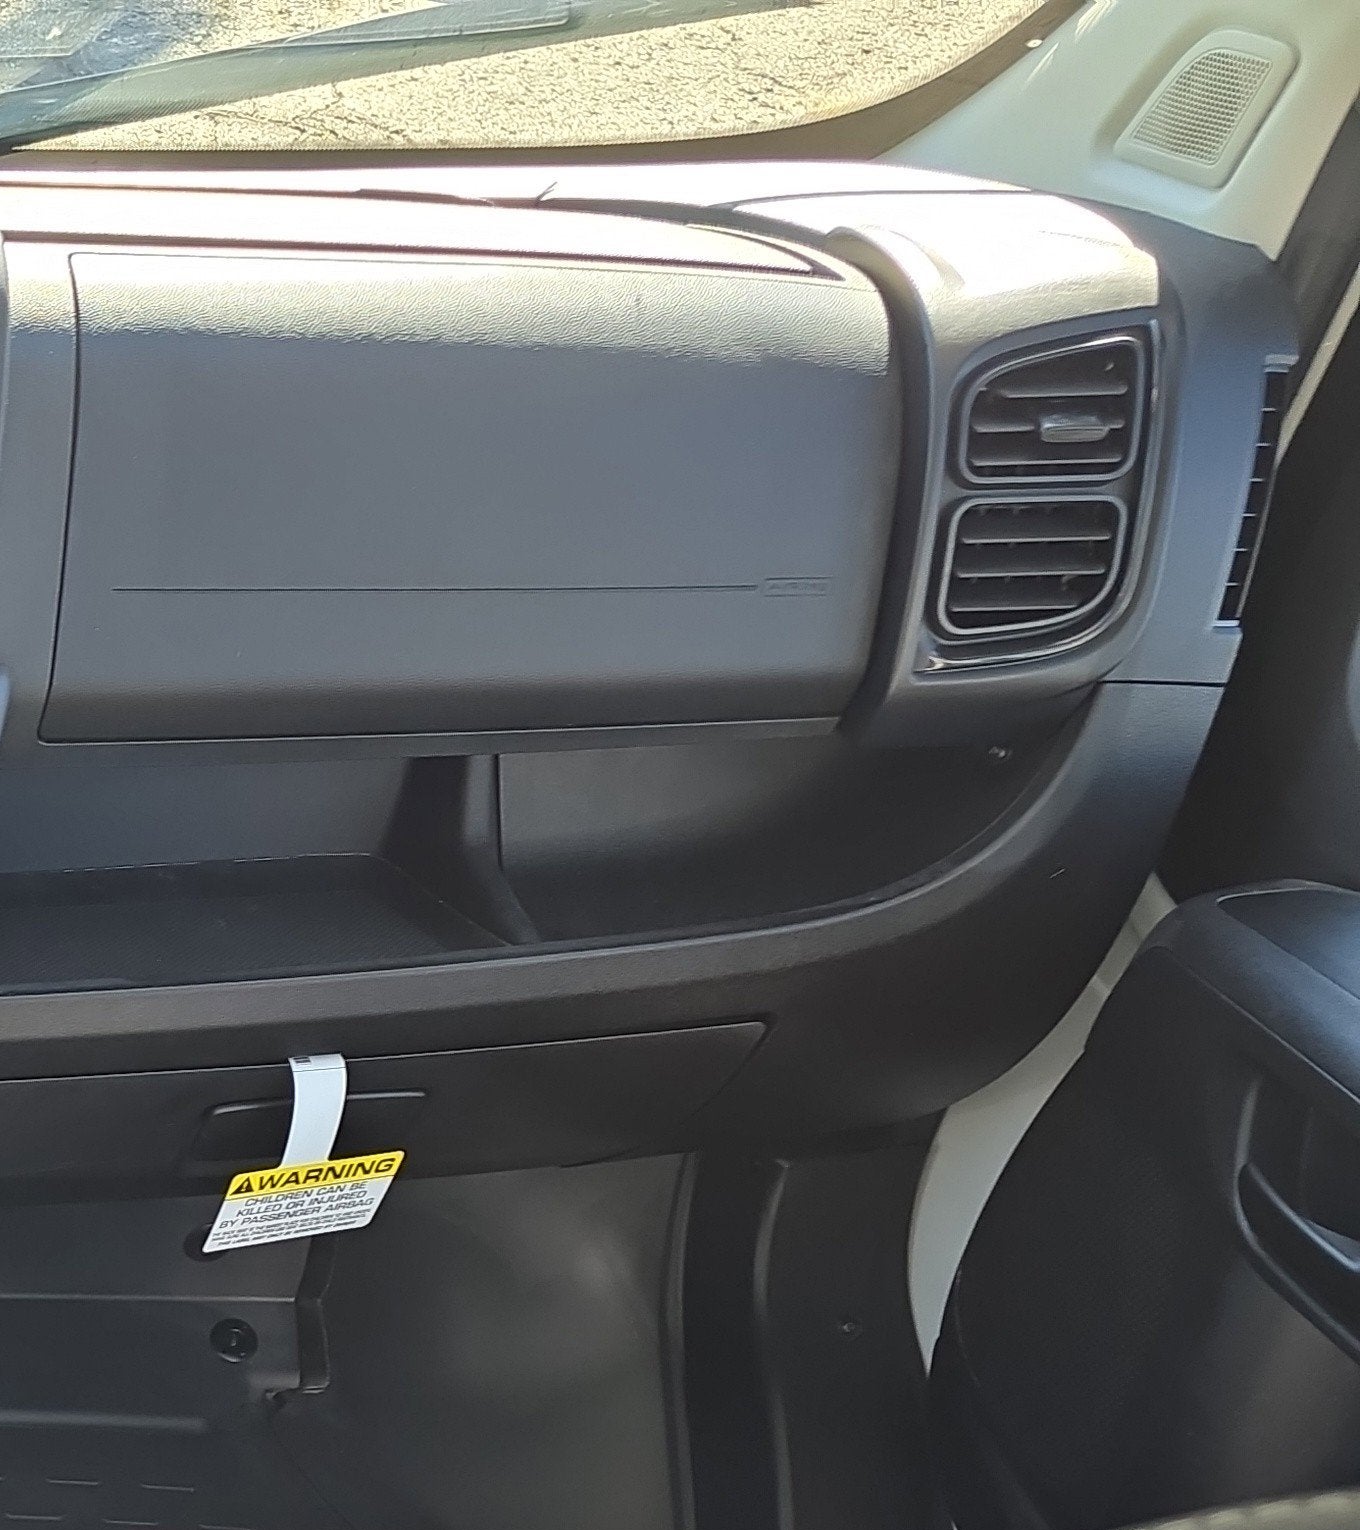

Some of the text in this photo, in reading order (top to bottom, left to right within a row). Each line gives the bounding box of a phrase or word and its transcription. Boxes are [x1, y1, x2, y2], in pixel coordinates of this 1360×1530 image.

[258, 1158, 395, 1191] WARNING
[236, 1191, 367, 1217] KILLED OR INJURED
[245, 1181, 367, 1206] CHILDREN CAN BE
[219, 1219, 239, 1228] BY
[241, 1206, 321, 1225] PASSENGER
[323, 1198, 374, 1212] AIRBAG
